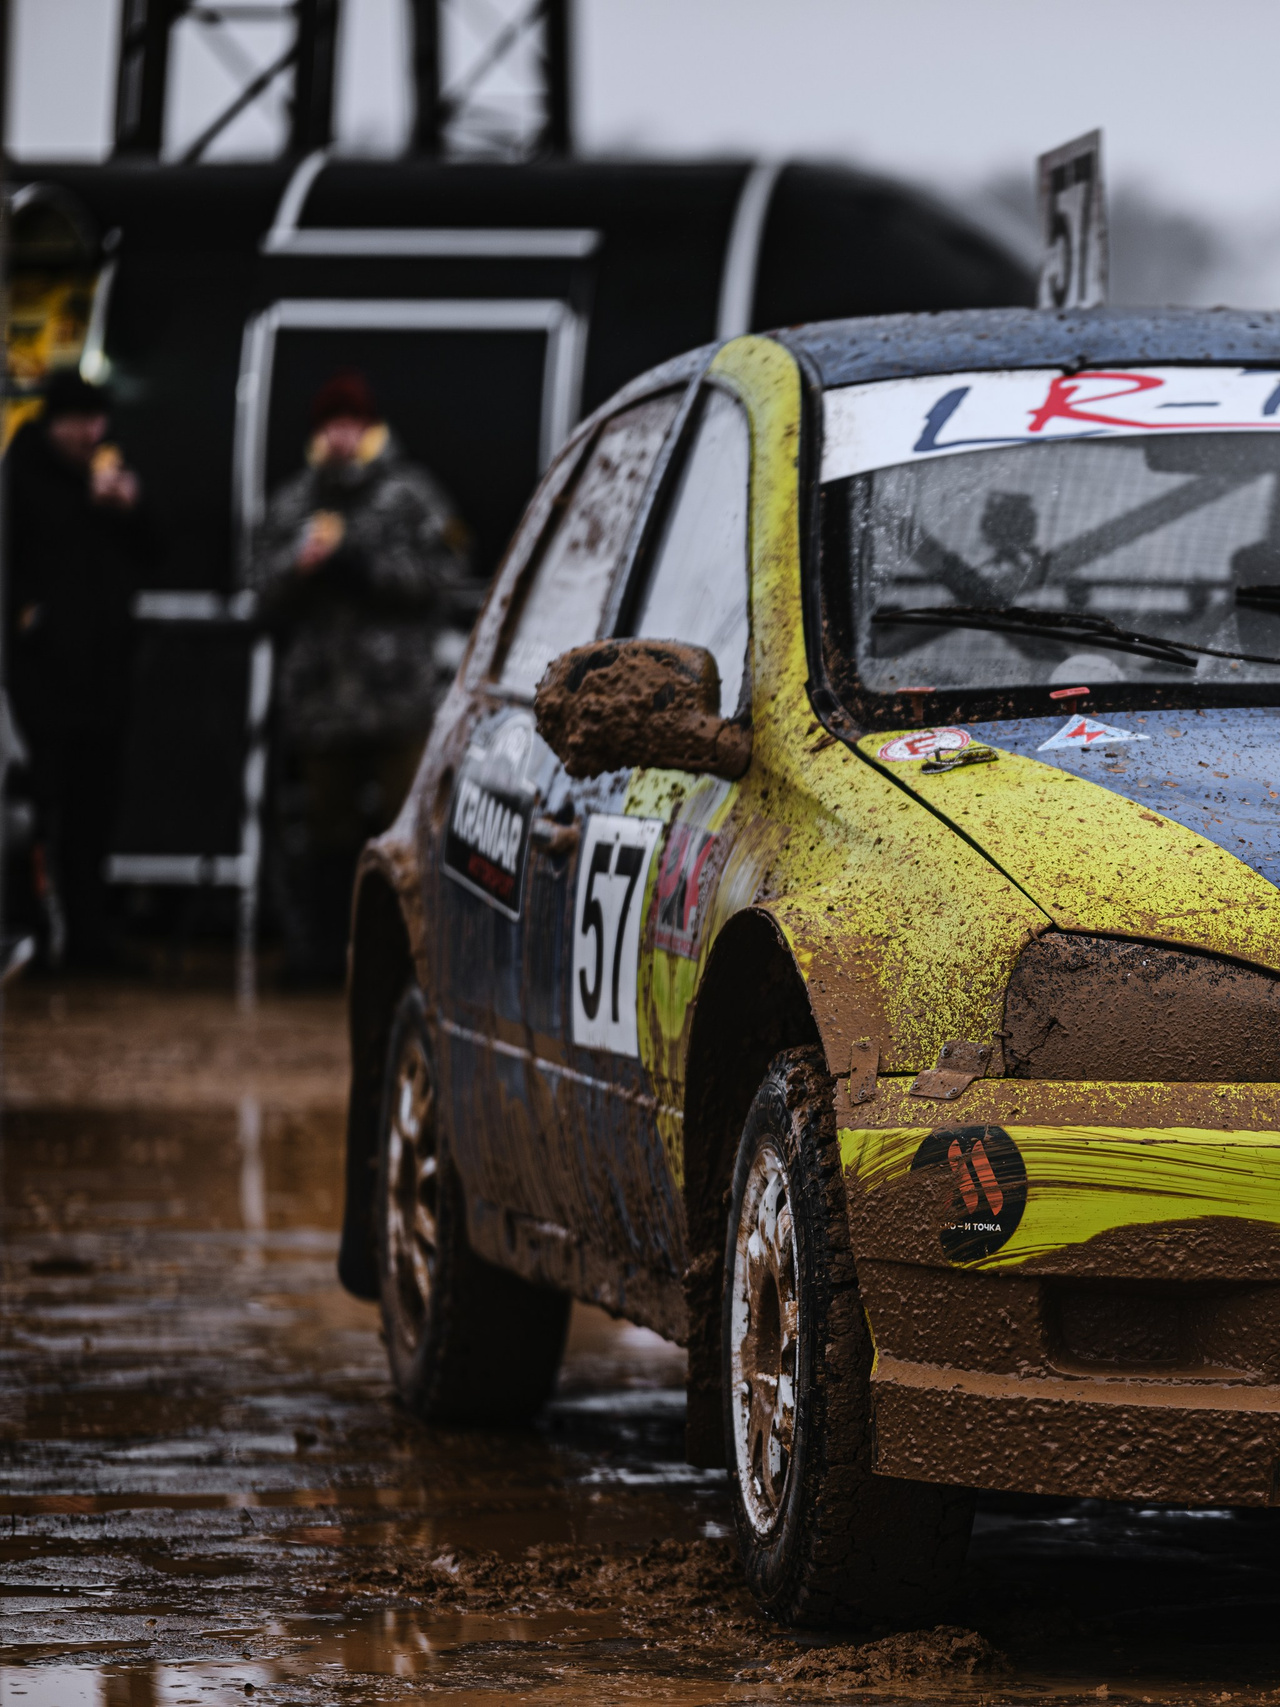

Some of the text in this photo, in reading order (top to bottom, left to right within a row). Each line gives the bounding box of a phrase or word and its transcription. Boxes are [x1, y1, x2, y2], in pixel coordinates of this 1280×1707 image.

[1047, 151, 1093, 309] 57
[453, 777, 524, 876] KRAMAR
[578, 841, 647, 1024] 57
[972, 1222, 1002, 1232] ТОЧКА
